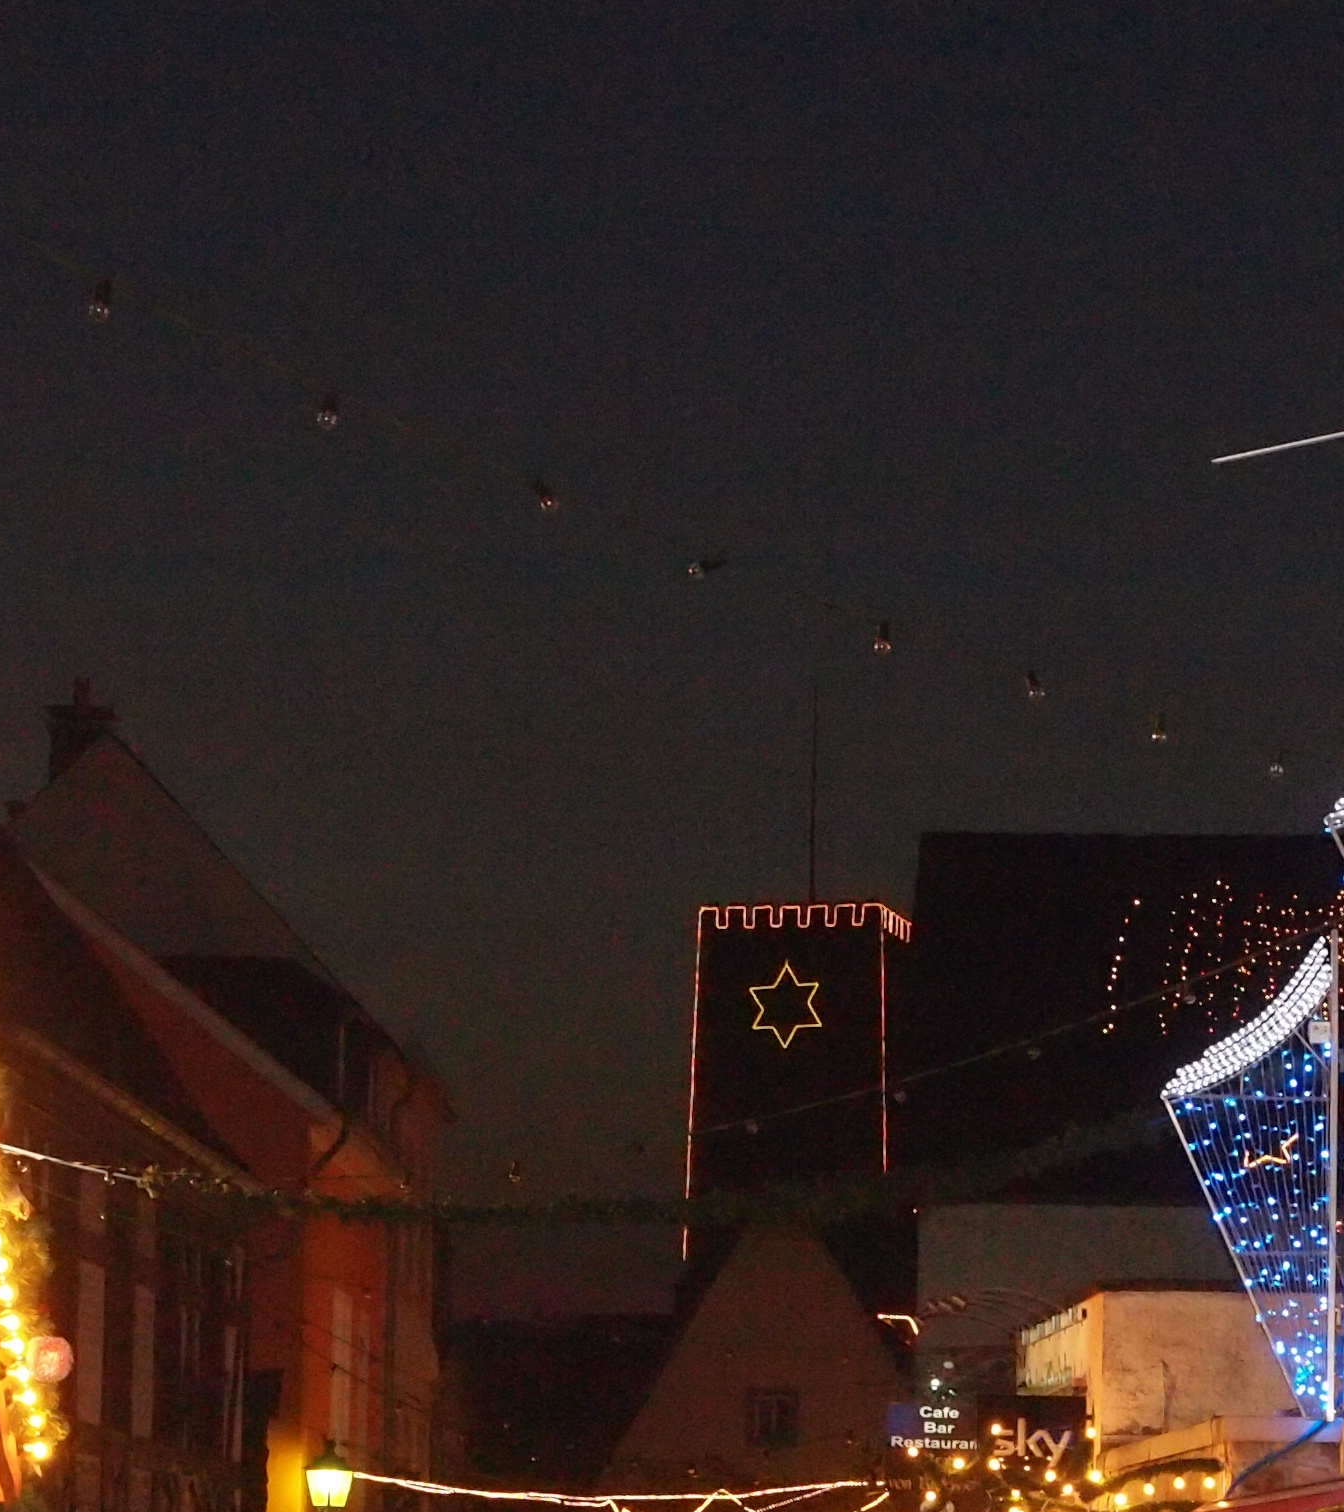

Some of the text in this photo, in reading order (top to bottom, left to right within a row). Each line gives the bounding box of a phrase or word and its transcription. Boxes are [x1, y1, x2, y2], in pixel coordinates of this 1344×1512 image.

[919, 1405, 960, 1419] Cafe
[923, 1421, 956, 1435] Bar
[993, 1417, 1072, 1470] sky
